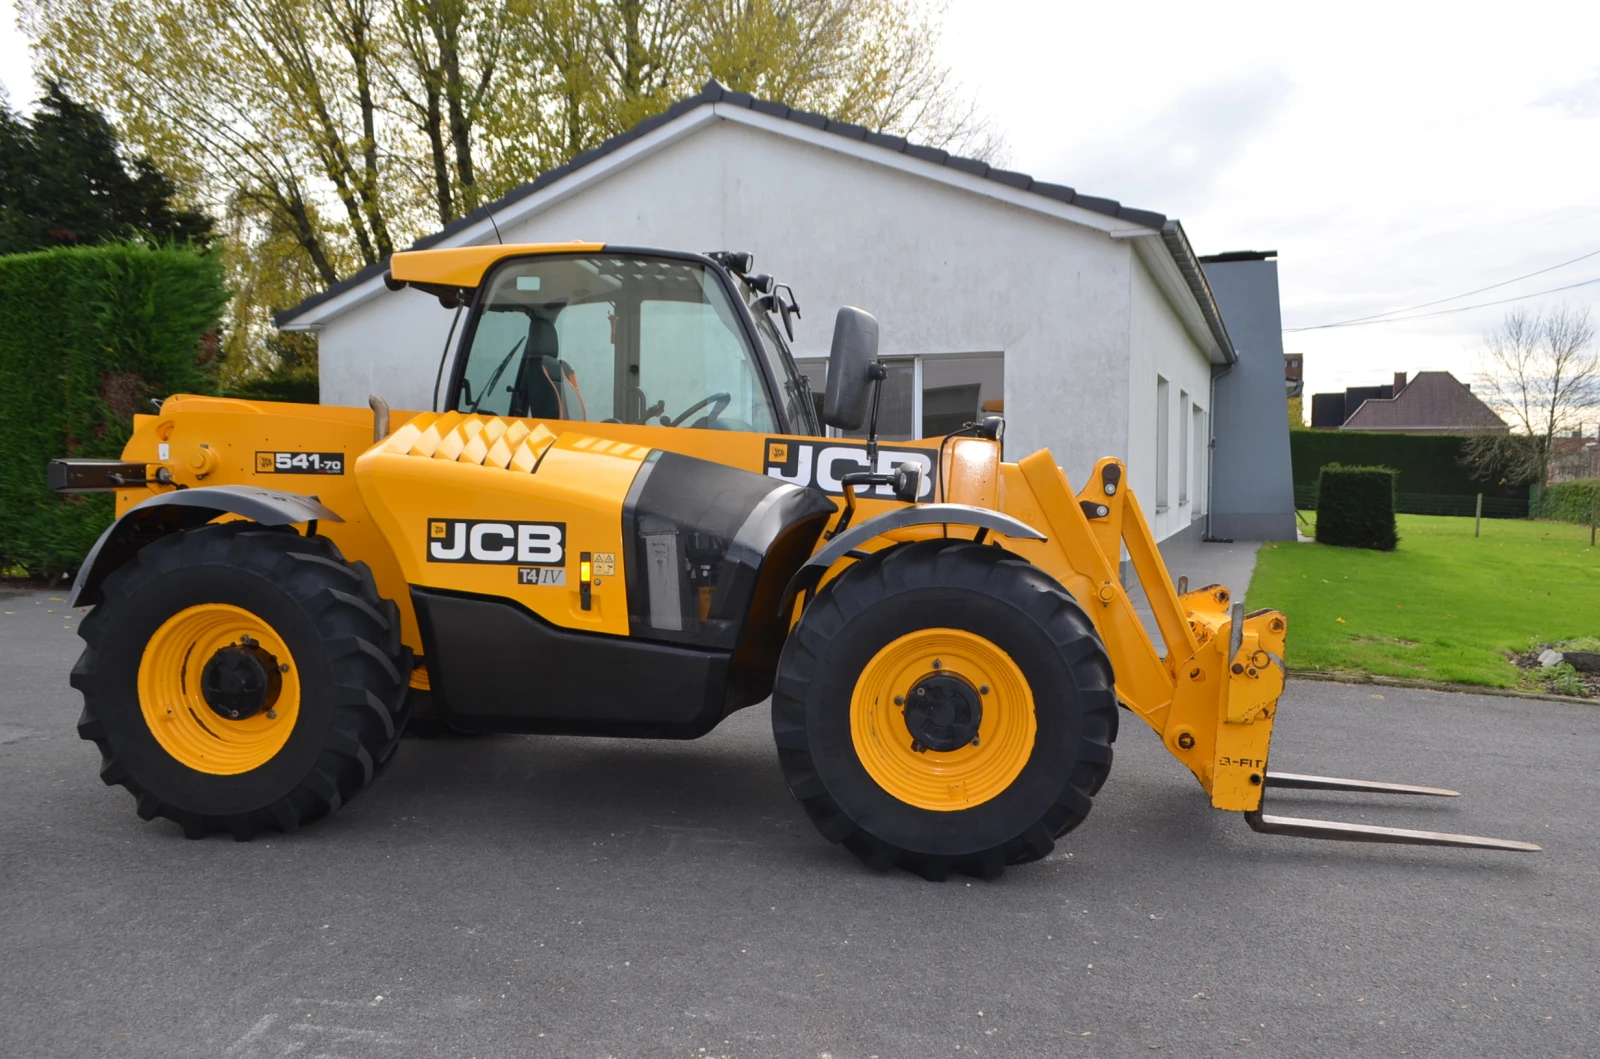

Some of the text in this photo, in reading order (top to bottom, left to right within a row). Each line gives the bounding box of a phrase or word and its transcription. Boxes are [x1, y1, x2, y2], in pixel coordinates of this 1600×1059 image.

[275, 453, 341, 469] 541-70
[767, 445, 931, 497] JCB
[430, 522, 563, 562] JCB
